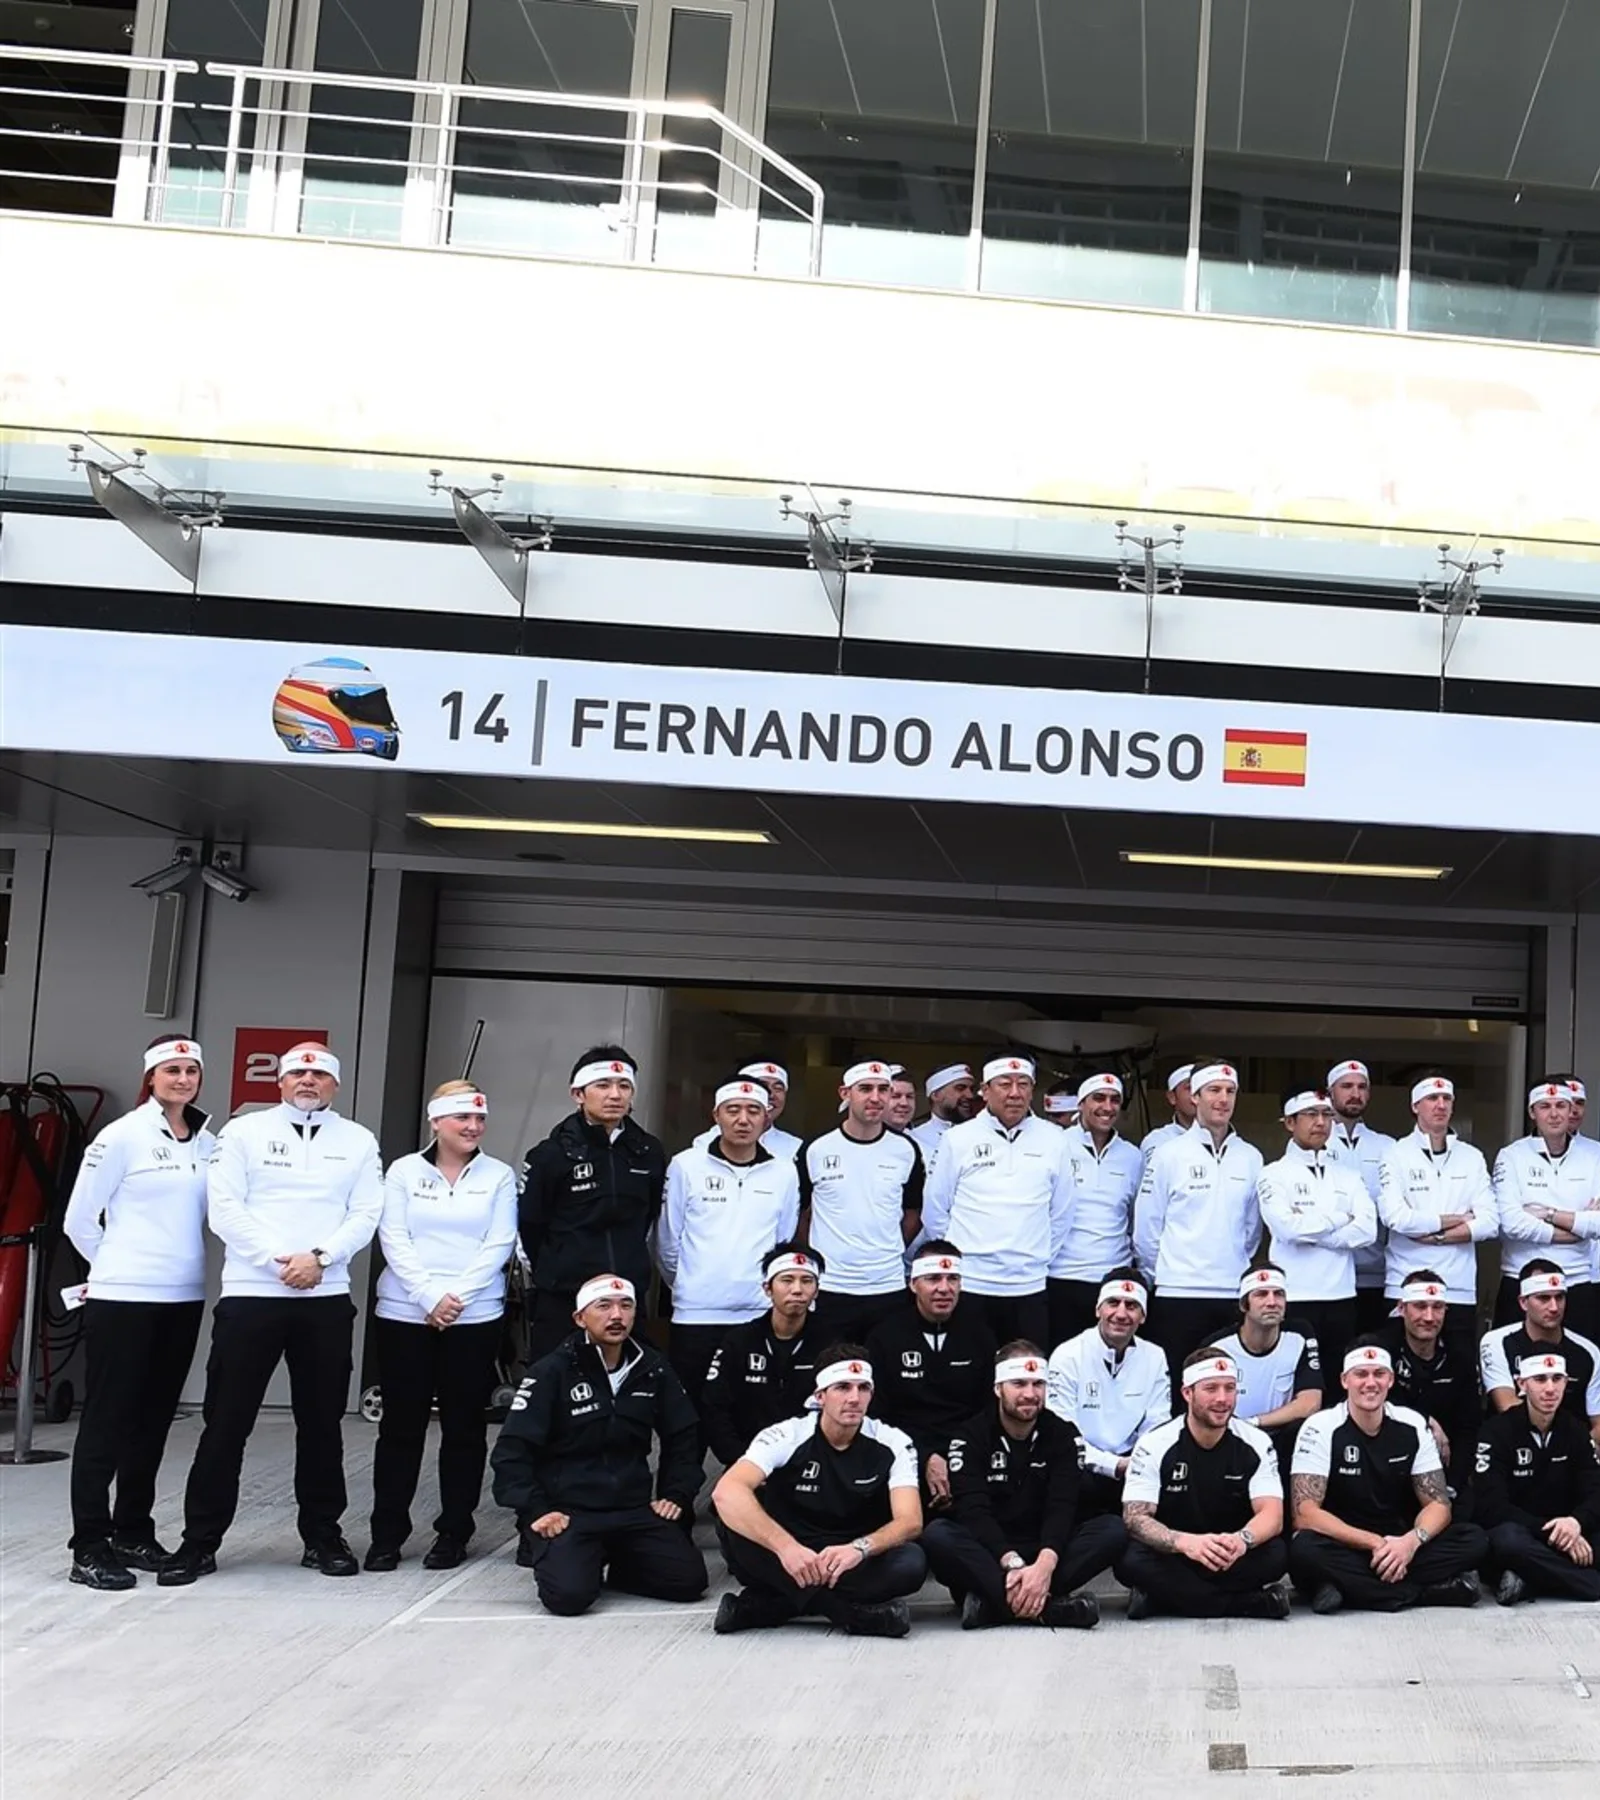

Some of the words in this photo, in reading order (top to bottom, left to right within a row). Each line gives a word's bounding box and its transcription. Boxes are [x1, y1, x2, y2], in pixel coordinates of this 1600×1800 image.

[441, 691, 509, 743] 14
[572, 699, 932, 767] FERNANDO
[951, 722, 1204, 782] ALONSO
